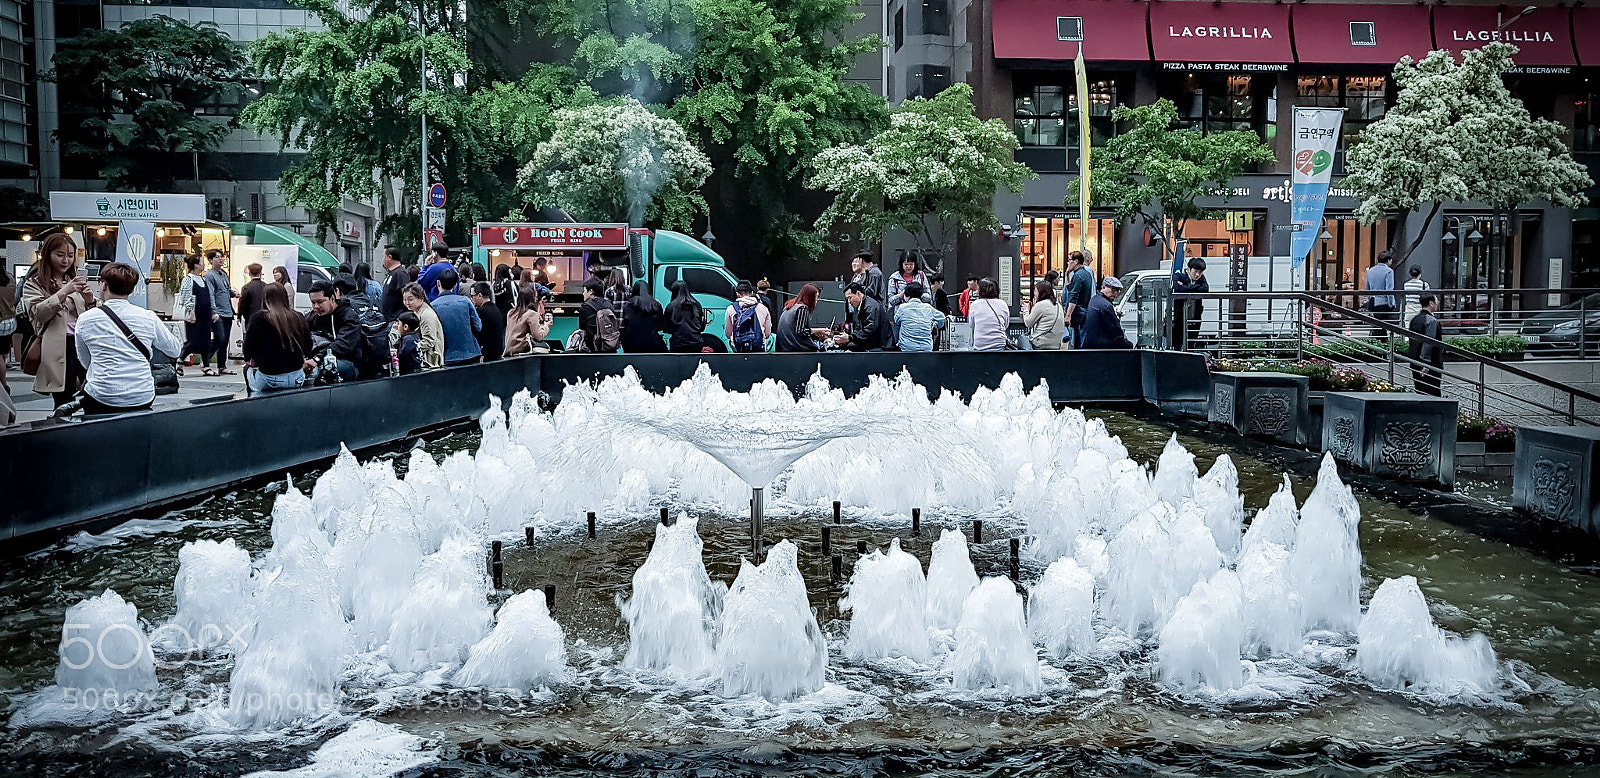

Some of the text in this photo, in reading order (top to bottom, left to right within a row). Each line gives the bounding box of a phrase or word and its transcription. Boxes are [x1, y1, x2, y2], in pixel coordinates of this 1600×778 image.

[1169, 26, 1273, 39] LAGRILLIA
[1453, 30, 1554, 42] LAGRILLIA
[1163, 62, 1186, 70] PIZZA
[1214, 63, 1240, 71] STEAK
[1298, 127, 1335, 140] 금연구역
[1232, 187, 1250, 196] DELI
[117, 199, 159, 210] 시현이네
[1239, 213, 1247, 228] 1
